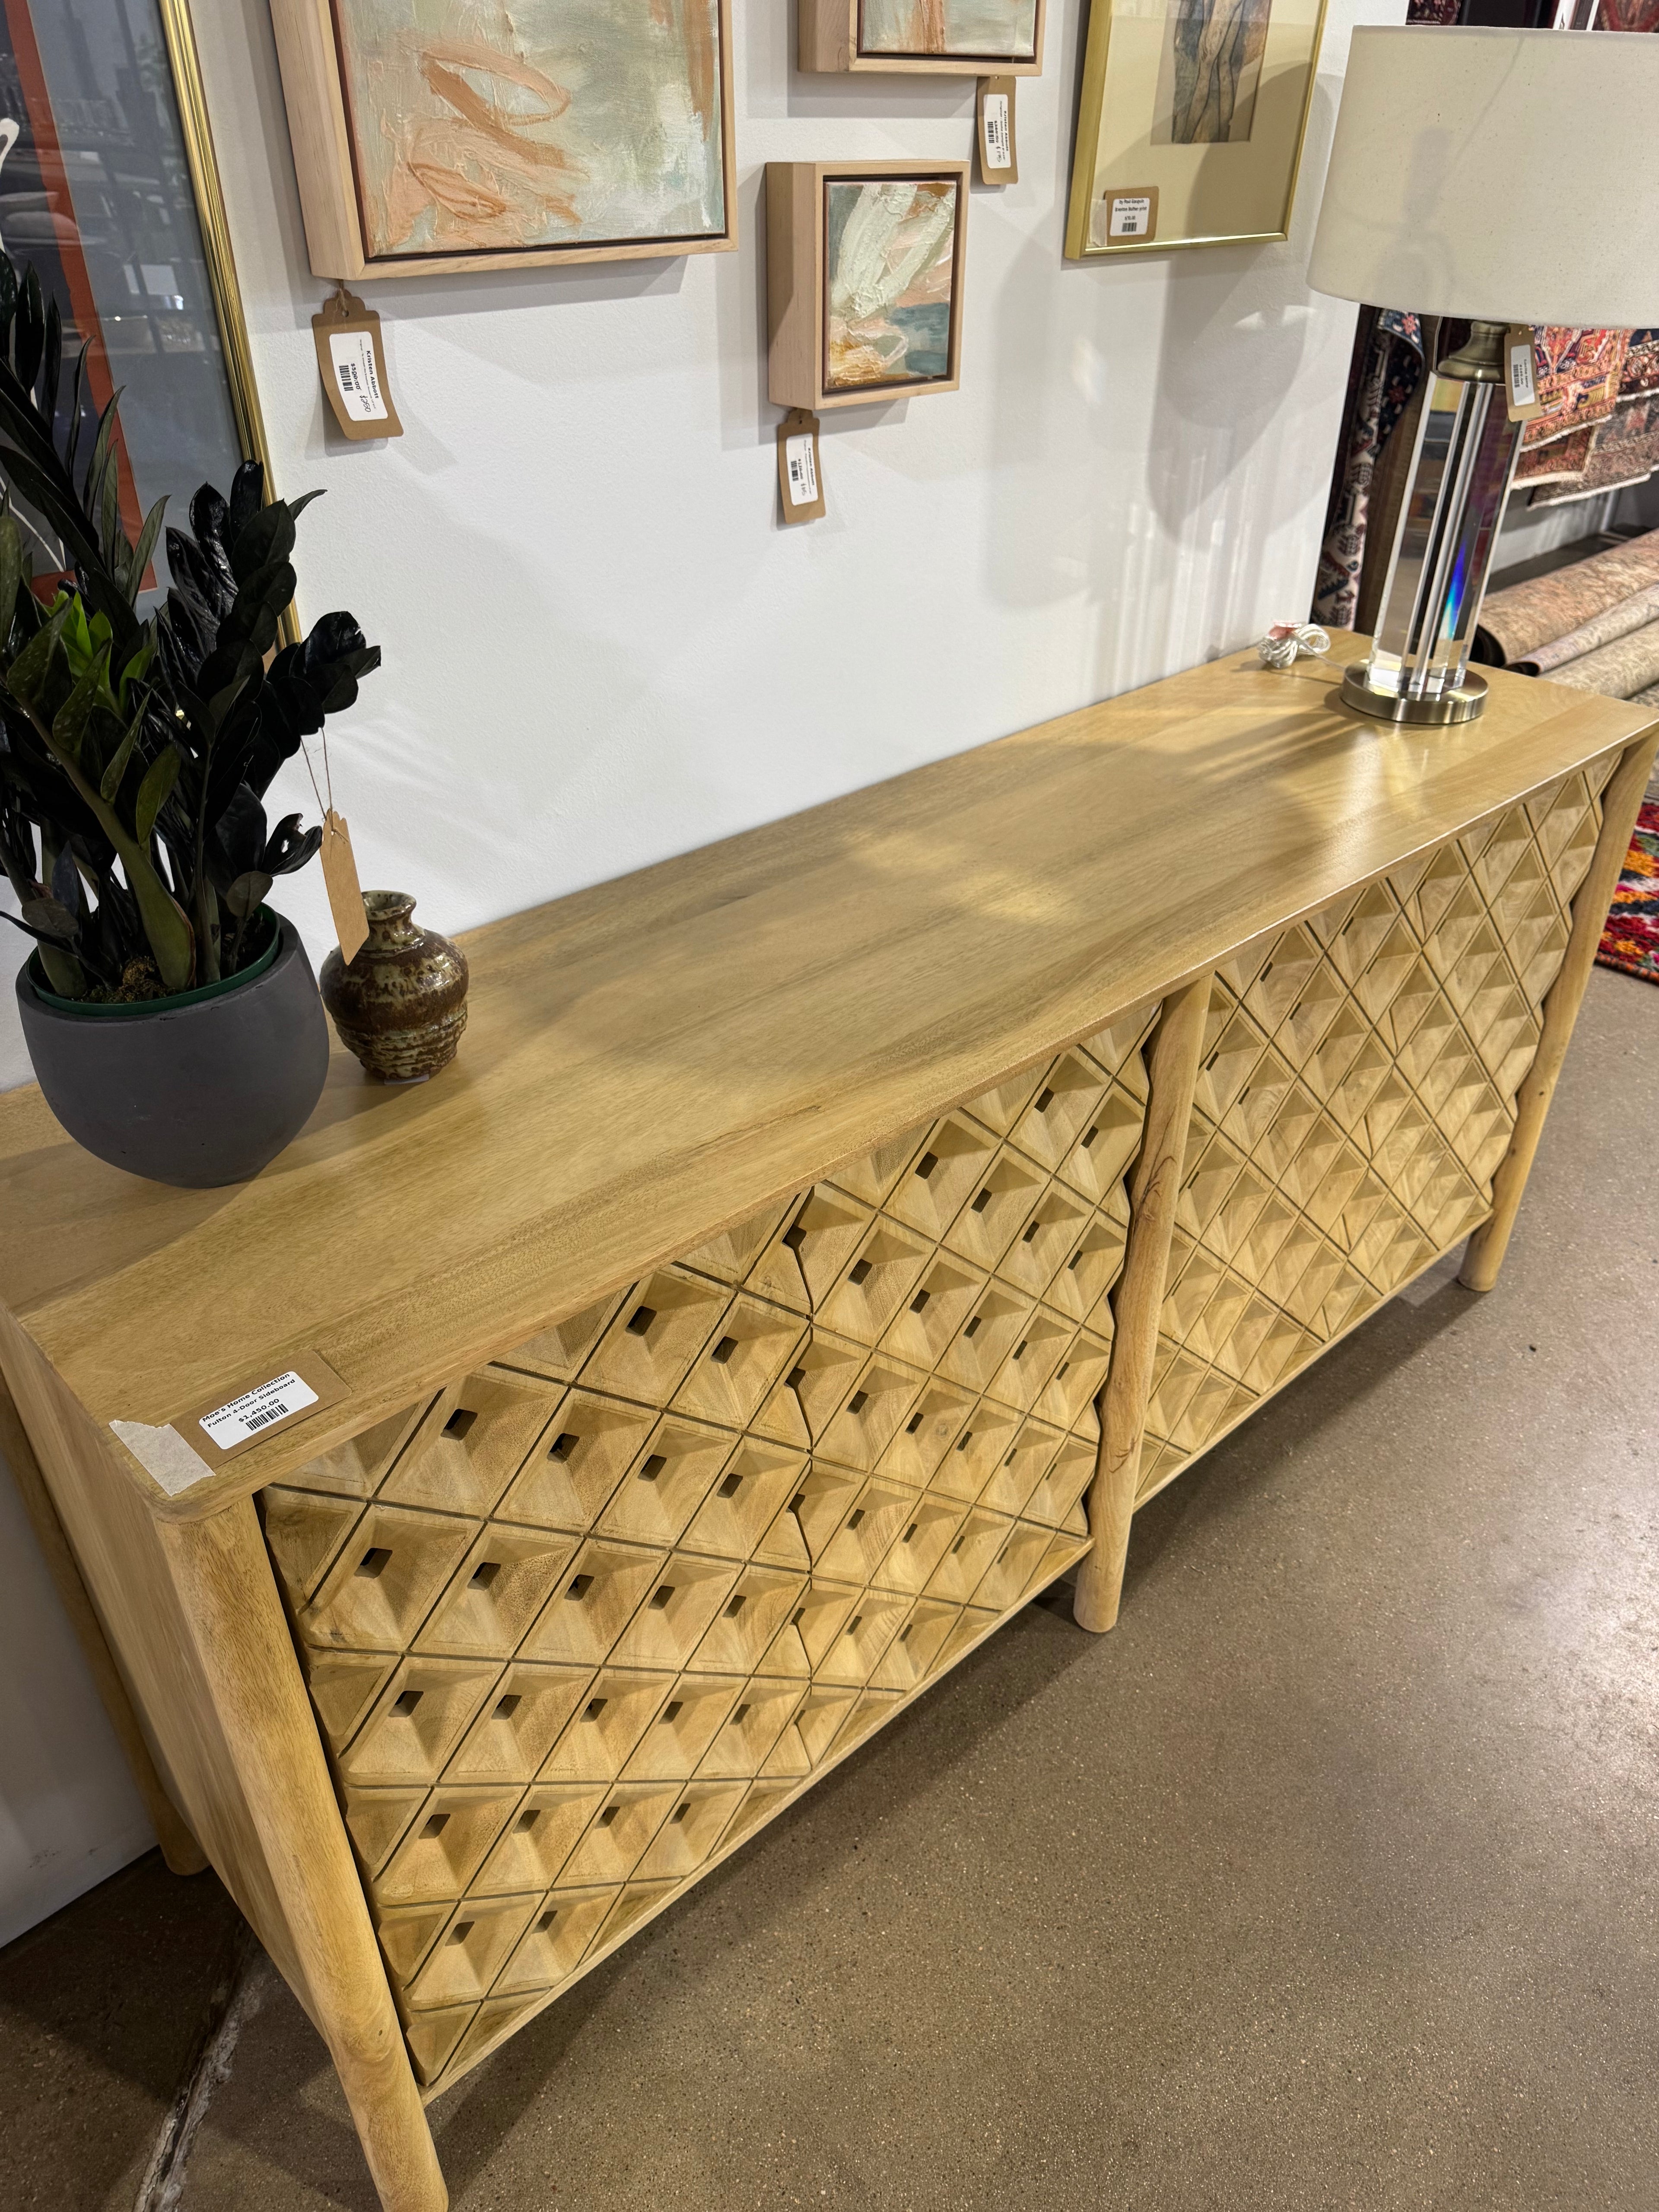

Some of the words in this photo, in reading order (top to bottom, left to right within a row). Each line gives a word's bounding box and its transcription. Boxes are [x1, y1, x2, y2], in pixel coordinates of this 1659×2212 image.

[370, 376, 379, 398] Abbott
[202, 1407, 226, 1422] Moe's
[227, 1394, 250, 1408] Home
[251, 1373, 290, 1395] Collection
[207, 1413, 232, 1427] Fulton
[233, 1398, 257, 1414] 4-Door
[258, 1379, 296, 1400] Sideboard
[238, 1398, 280, 1423] $1,450.00
